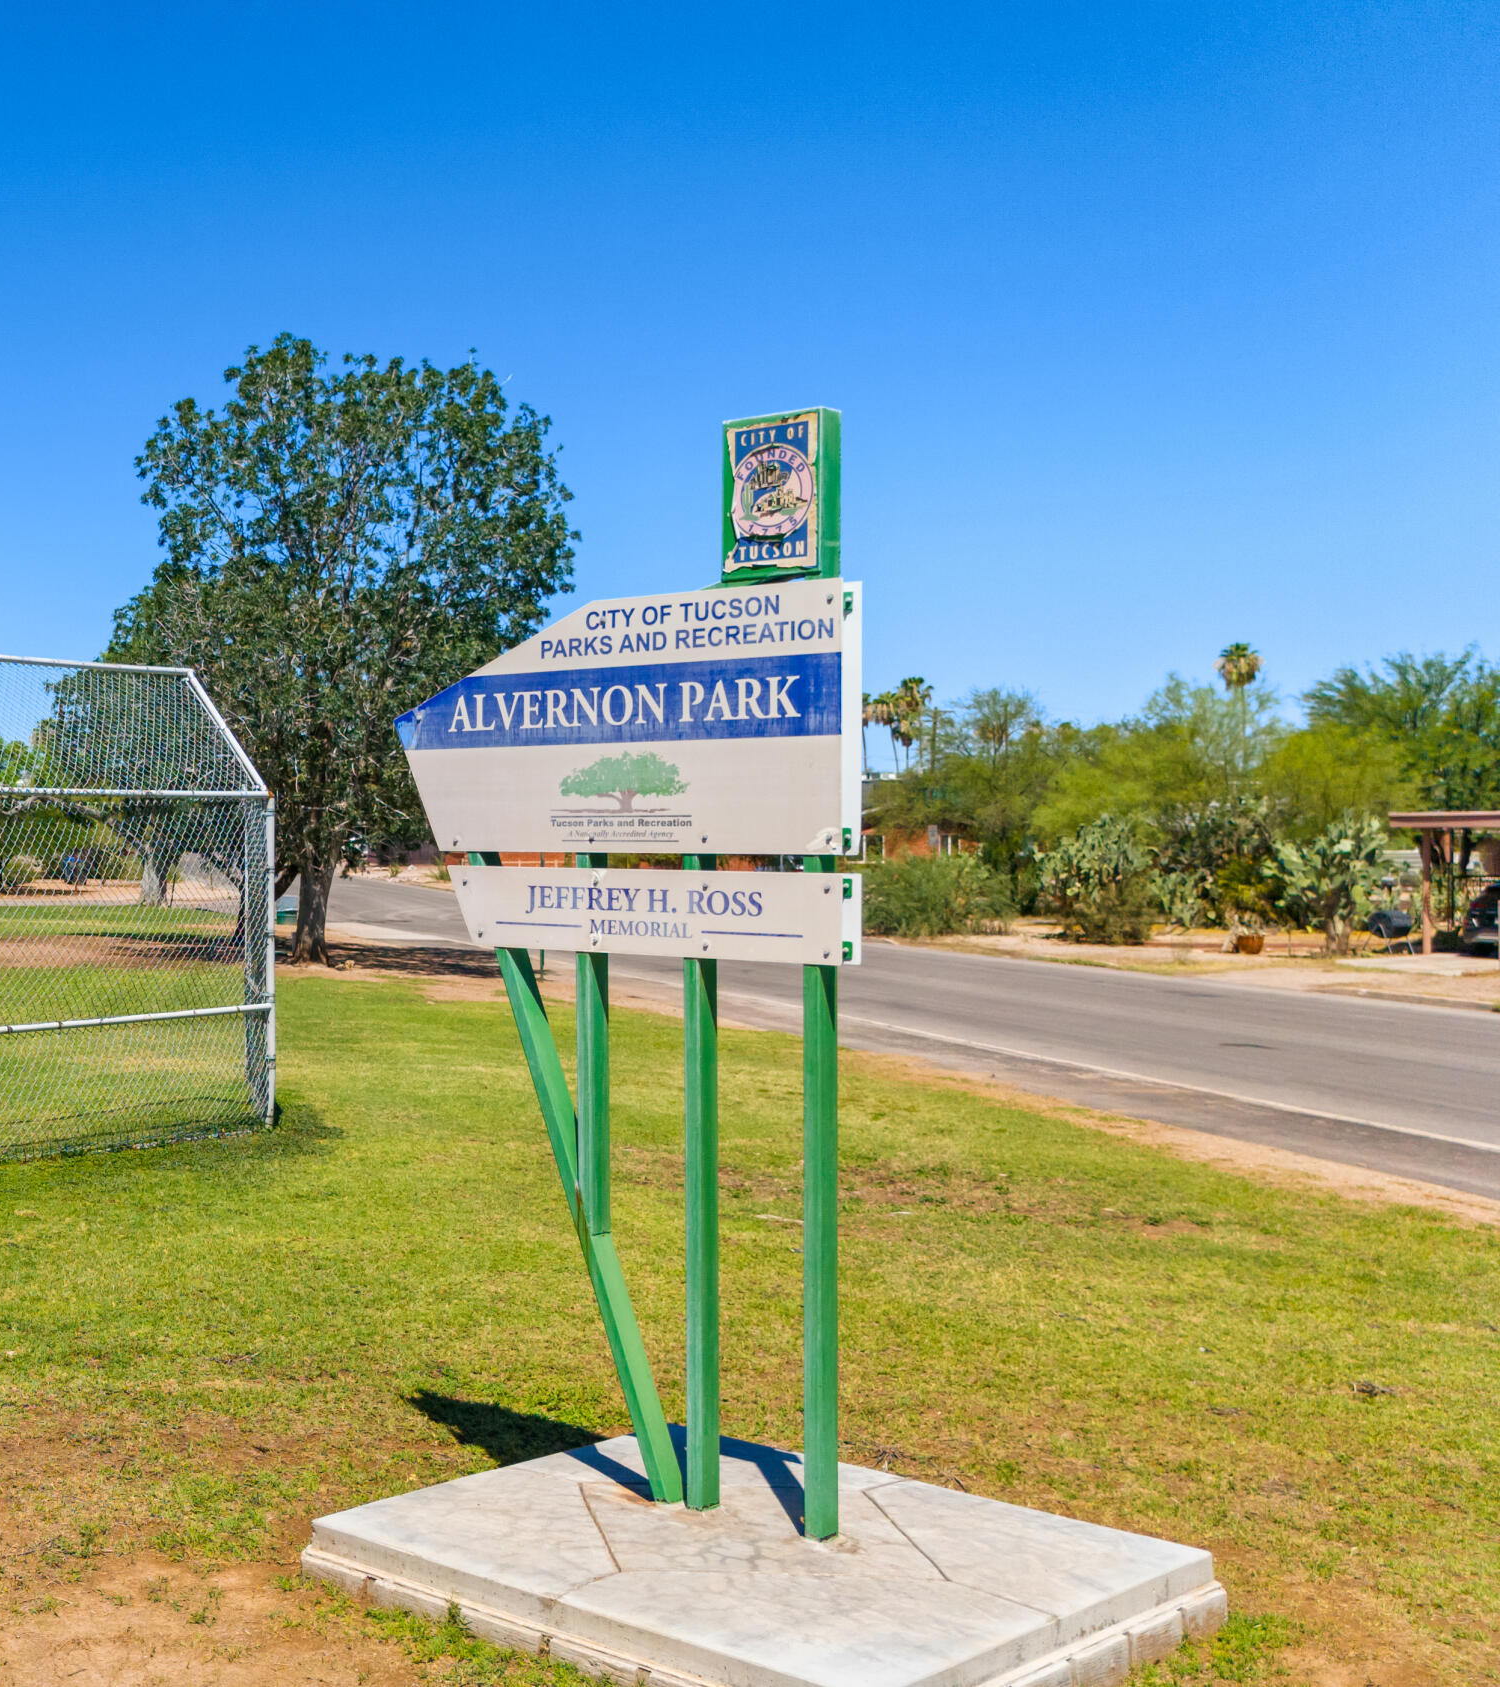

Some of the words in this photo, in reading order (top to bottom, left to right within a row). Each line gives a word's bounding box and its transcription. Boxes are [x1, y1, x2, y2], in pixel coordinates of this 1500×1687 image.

[740, 429, 776, 447] CITY
[786, 425, 804, 440] OF
[737, 447, 806, 481] FOUNDED
[748, 515, 798, 535] 1775
[739, 540, 806, 561] TUCSON
[585, 607, 635, 631] CITY
[641, 604, 673, 626] OF
[679, 594, 780, 622] TUCSON
[540, 635, 613, 659] PARKS
[619, 631, 667, 654] AND
[675, 617, 835, 649] RECREATION
[447, 683, 668, 733] ALVERNON
[678, 675, 802, 723] PARK
[551, 819, 584, 827] Tucson
[587, 819, 614, 827] Parks
[617, 818, 635, 827] and
[638, 818, 693, 827] Recreation
[525, 885, 641, 914] JEFFREY
[647, 888, 677, 914] H.
[687, 889, 763, 917] ROSS
[589, 918, 693, 939] MEMORIAL
